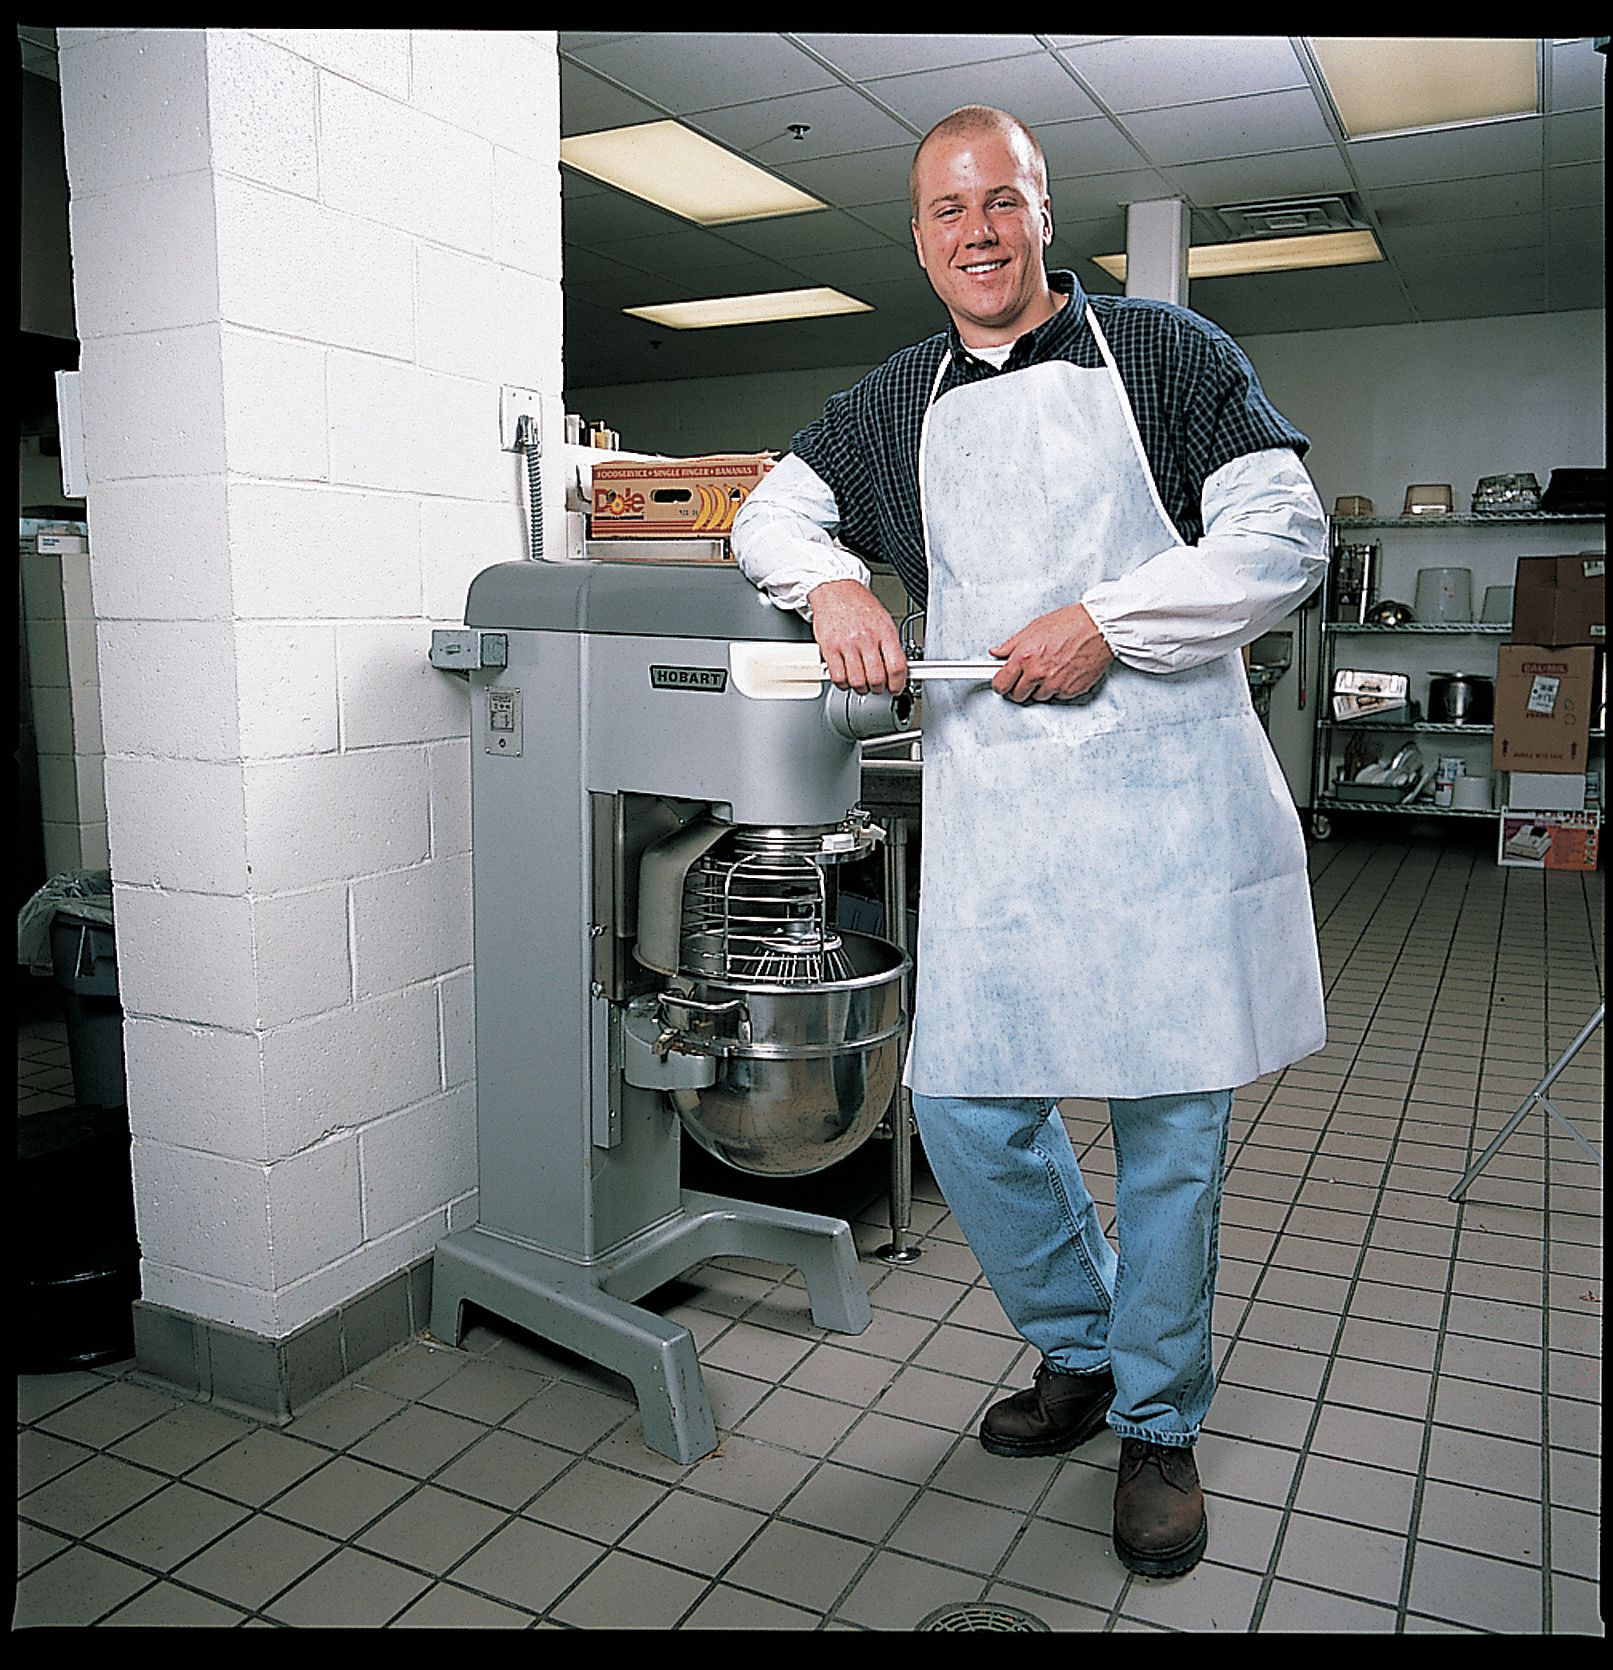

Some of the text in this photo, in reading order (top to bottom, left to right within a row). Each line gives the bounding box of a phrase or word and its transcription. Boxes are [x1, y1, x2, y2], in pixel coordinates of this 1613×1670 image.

[597, 467, 752, 478] FOODSERVICE SINGLE FINGER BANANAS
[594, 488, 645, 515] Dole
[656, 670, 721, 685] HOBART
